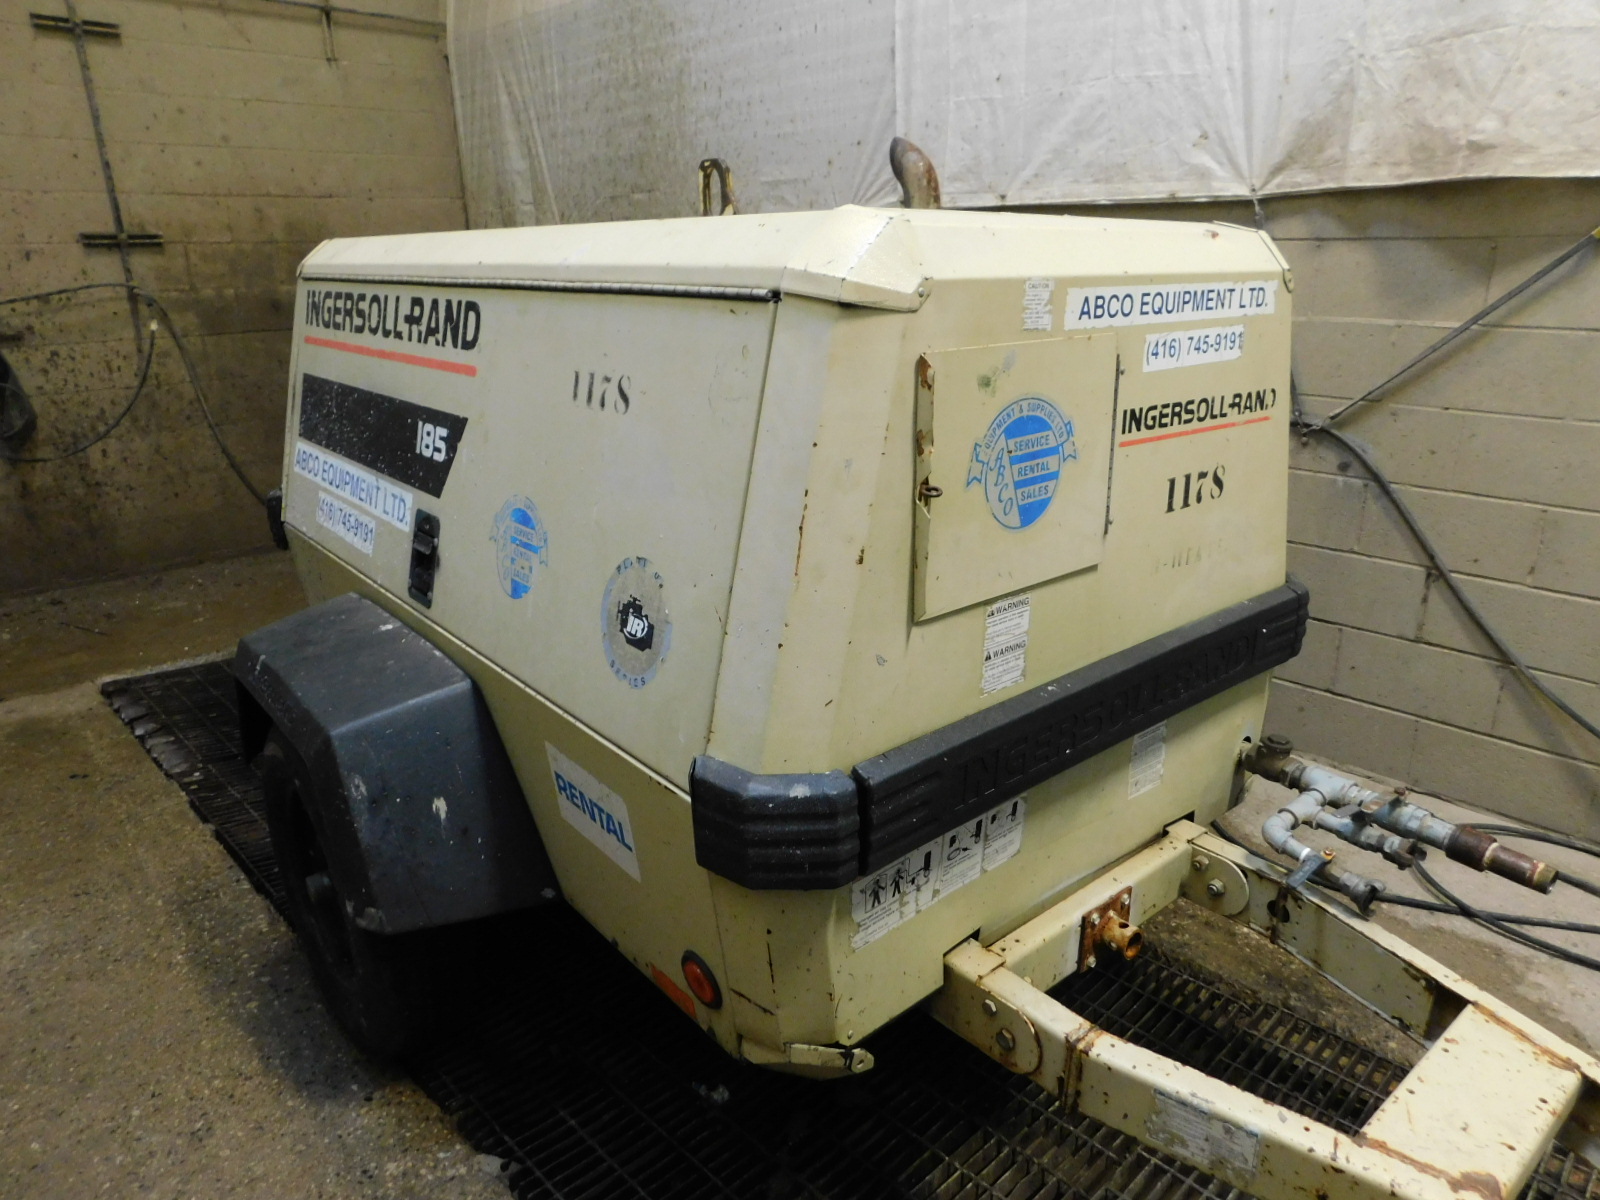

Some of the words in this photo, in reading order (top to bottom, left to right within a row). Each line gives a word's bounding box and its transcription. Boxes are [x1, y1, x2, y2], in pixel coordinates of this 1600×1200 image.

[305, 289, 481, 351] INGERSOLL-RAND
[1078, 293, 1134, 321] ABCO
[1139, 288, 1236, 316] EQUIPMENT
[1238, 286, 1269, 309] LTD.
[1145, 337, 1182, 366] (416)
[1186, 331, 1244, 357] 745-9191
[572, 370, 632, 415] 1178
[415, 420, 448, 463] 185
[1013, 434, 1050, 453] SERVICE
[295, 447, 320, 478] ABCO
[321, 460, 380, 509] EQUIPMENT
[382, 488, 409, 527] LTD.
[1017, 461, 1050, 478] RENTAL
[1164, 461, 1226, 514] 1178
[1020, 484, 1050, 502] SALES
[317, 499, 337, 527] (416)
[336, 507, 374, 544] 745-9191
[996, 597, 1030, 615] WARNING
[993, 640, 1027, 659] WARNING
[554, 770, 633, 853] RENTAL
